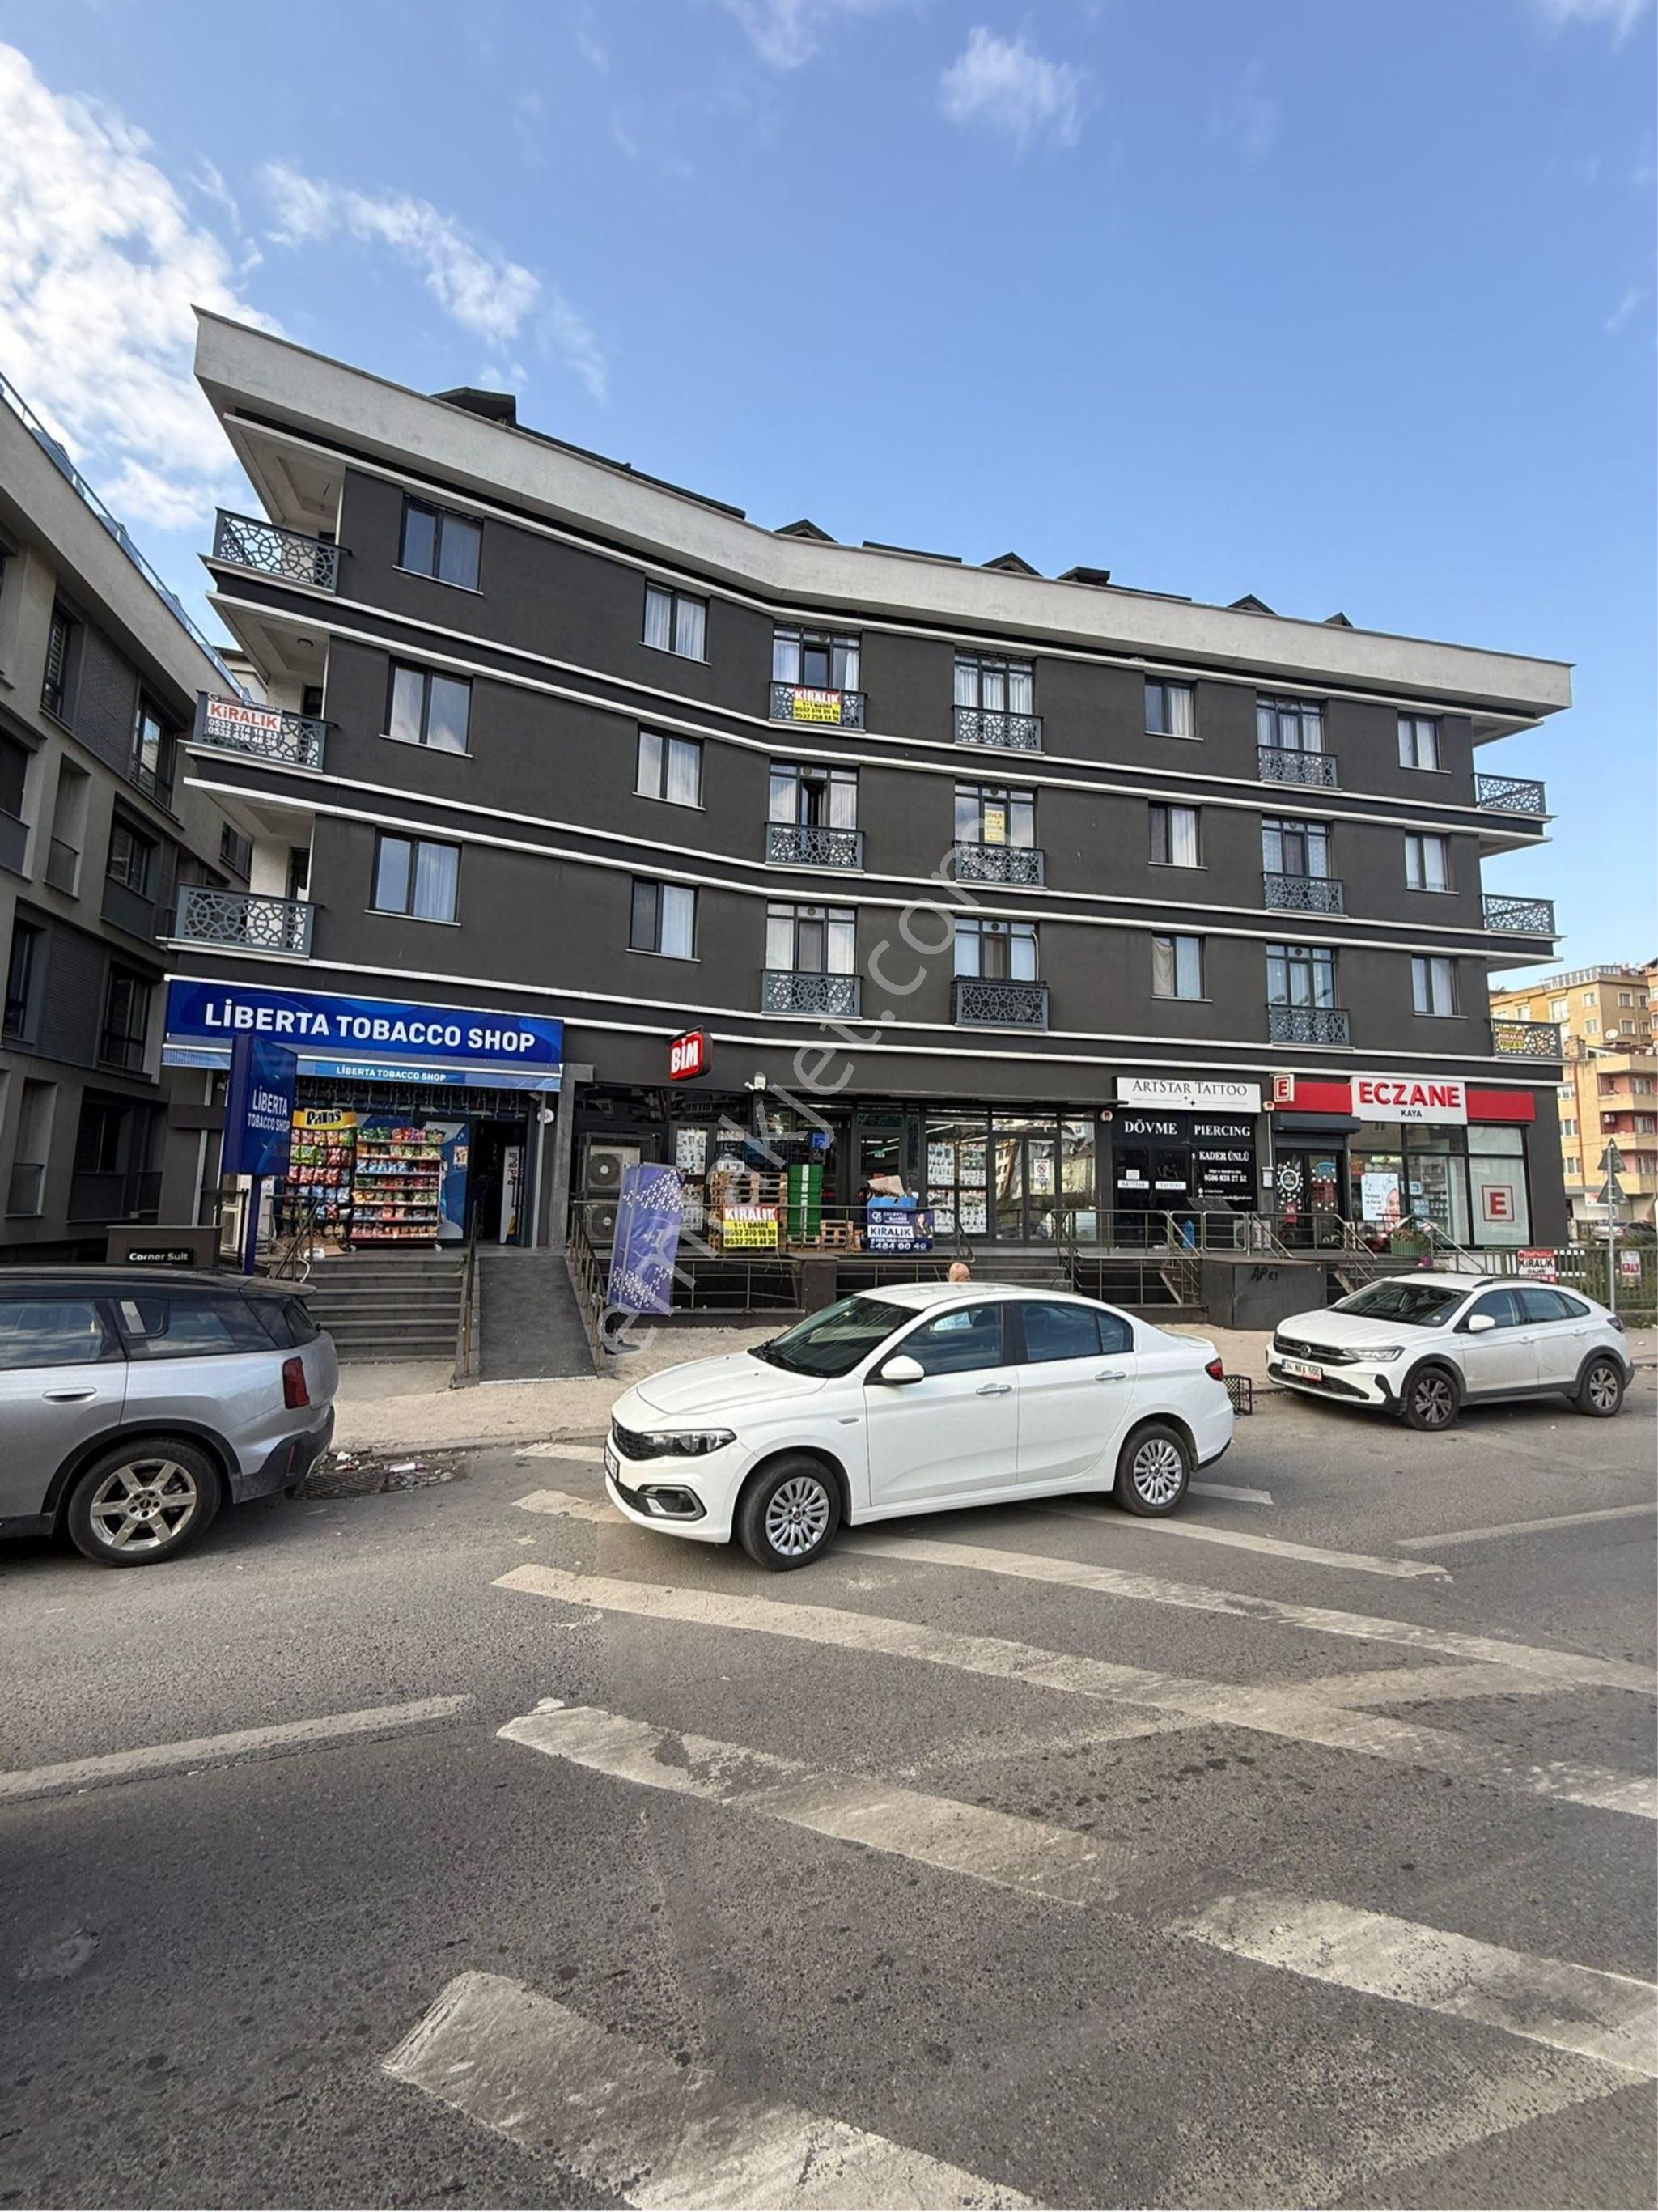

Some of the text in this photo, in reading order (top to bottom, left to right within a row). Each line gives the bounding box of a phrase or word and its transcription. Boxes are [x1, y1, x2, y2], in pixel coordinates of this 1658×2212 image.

[207, 726, 231, 738] 0532
[208, 718, 232, 729] 0532
[234, 724, 251, 734] 374
[205, 999, 536, 1052] LİBERTA TOBACCO SHOP
[671, 1038, 699, 1074] BİM
[336, 1064, 447, 1082] LİBERTA TOBACCO SHOP
[1278, 1081, 1288, 1097] E
[1359, 1081, 1461, 1108] ECZANE
[252, 1085, 289, 1117] LİBERTA
[248, 1112, 290, 1133] TOBACCO SHOP
[1401, 1109, 1423, 1119] KAYA
[1124, 1119, 1251, 1137] DÖVME PIERCING
[1199, 1150, 1227, 1161] KADER
[1489, 1192, 1507, 1215] E
[725, 1238, 744, 1246] 0532
[129, 1252, 189, 1261] Corner Suit
